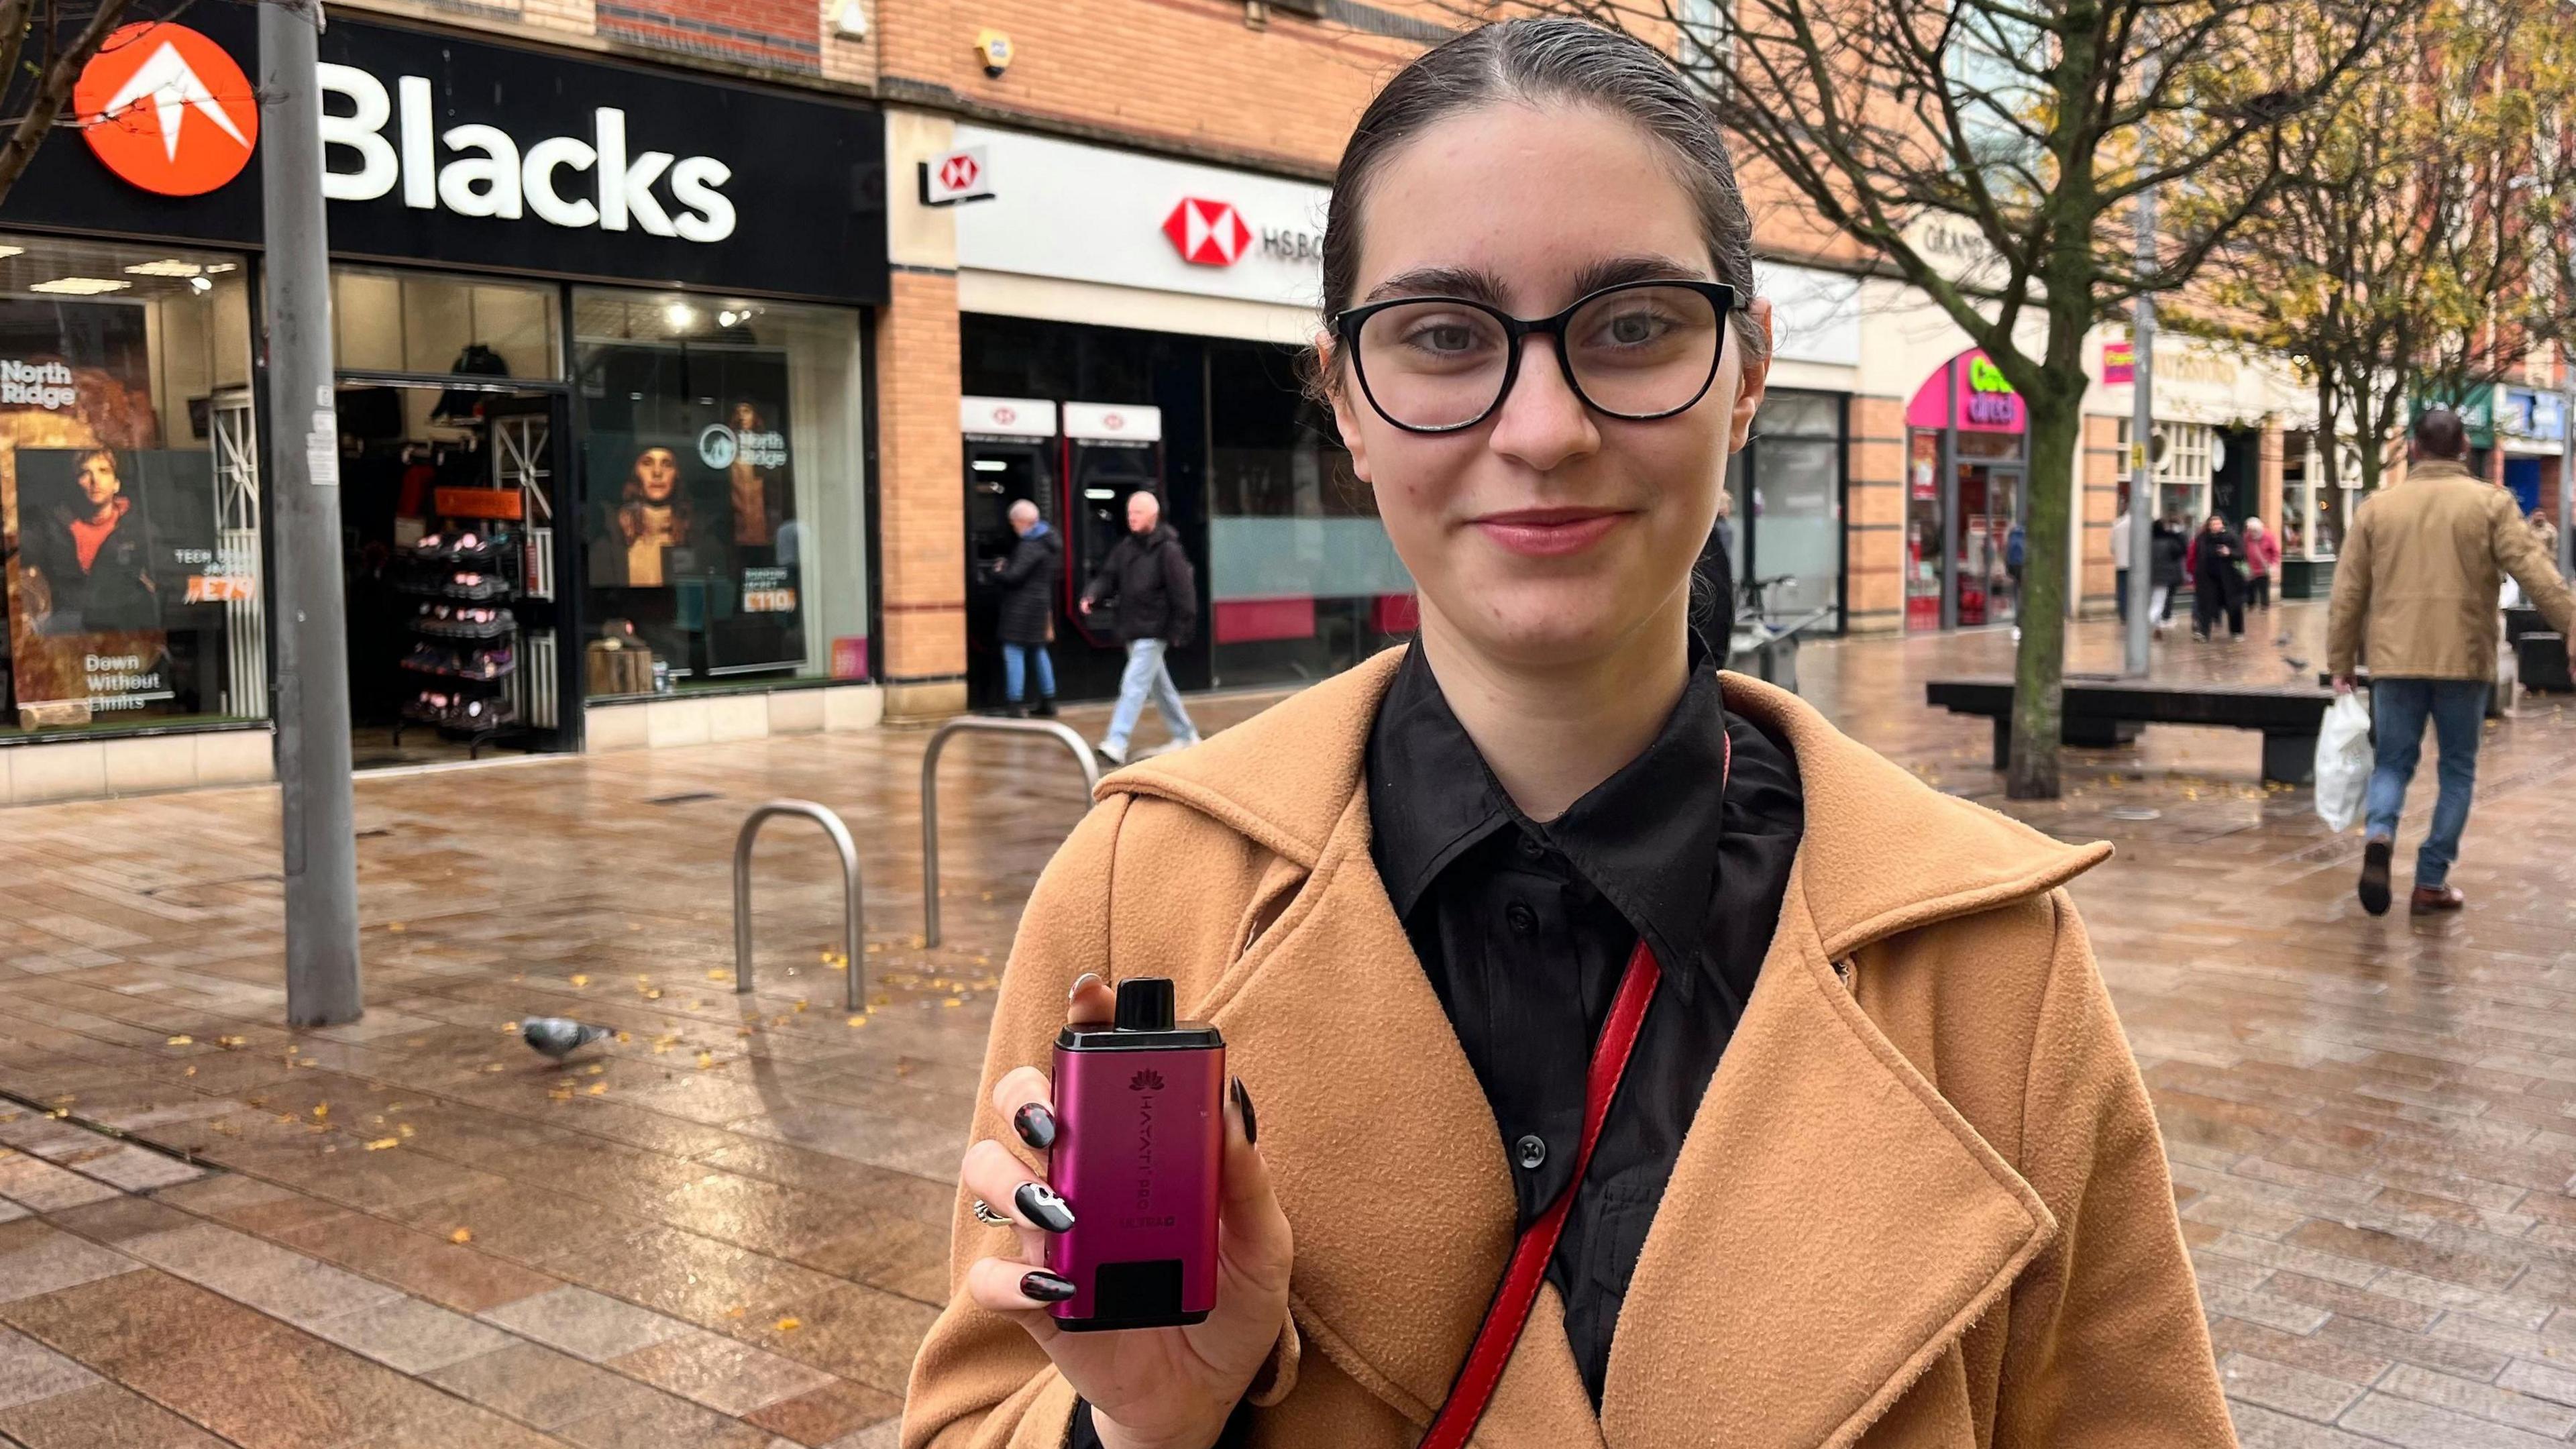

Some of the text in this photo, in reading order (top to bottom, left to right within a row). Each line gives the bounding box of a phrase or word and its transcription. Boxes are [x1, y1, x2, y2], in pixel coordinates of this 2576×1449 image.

[317, 61, 737, 244] Blacks
[1, 360, 72, 384] North
[1, 382, 75, 410] Ridge
[85, 653, 140, 672] Down
[87, 672, 161, 692] Without
[1138, 1095, 1153, 1170] HAYATI
